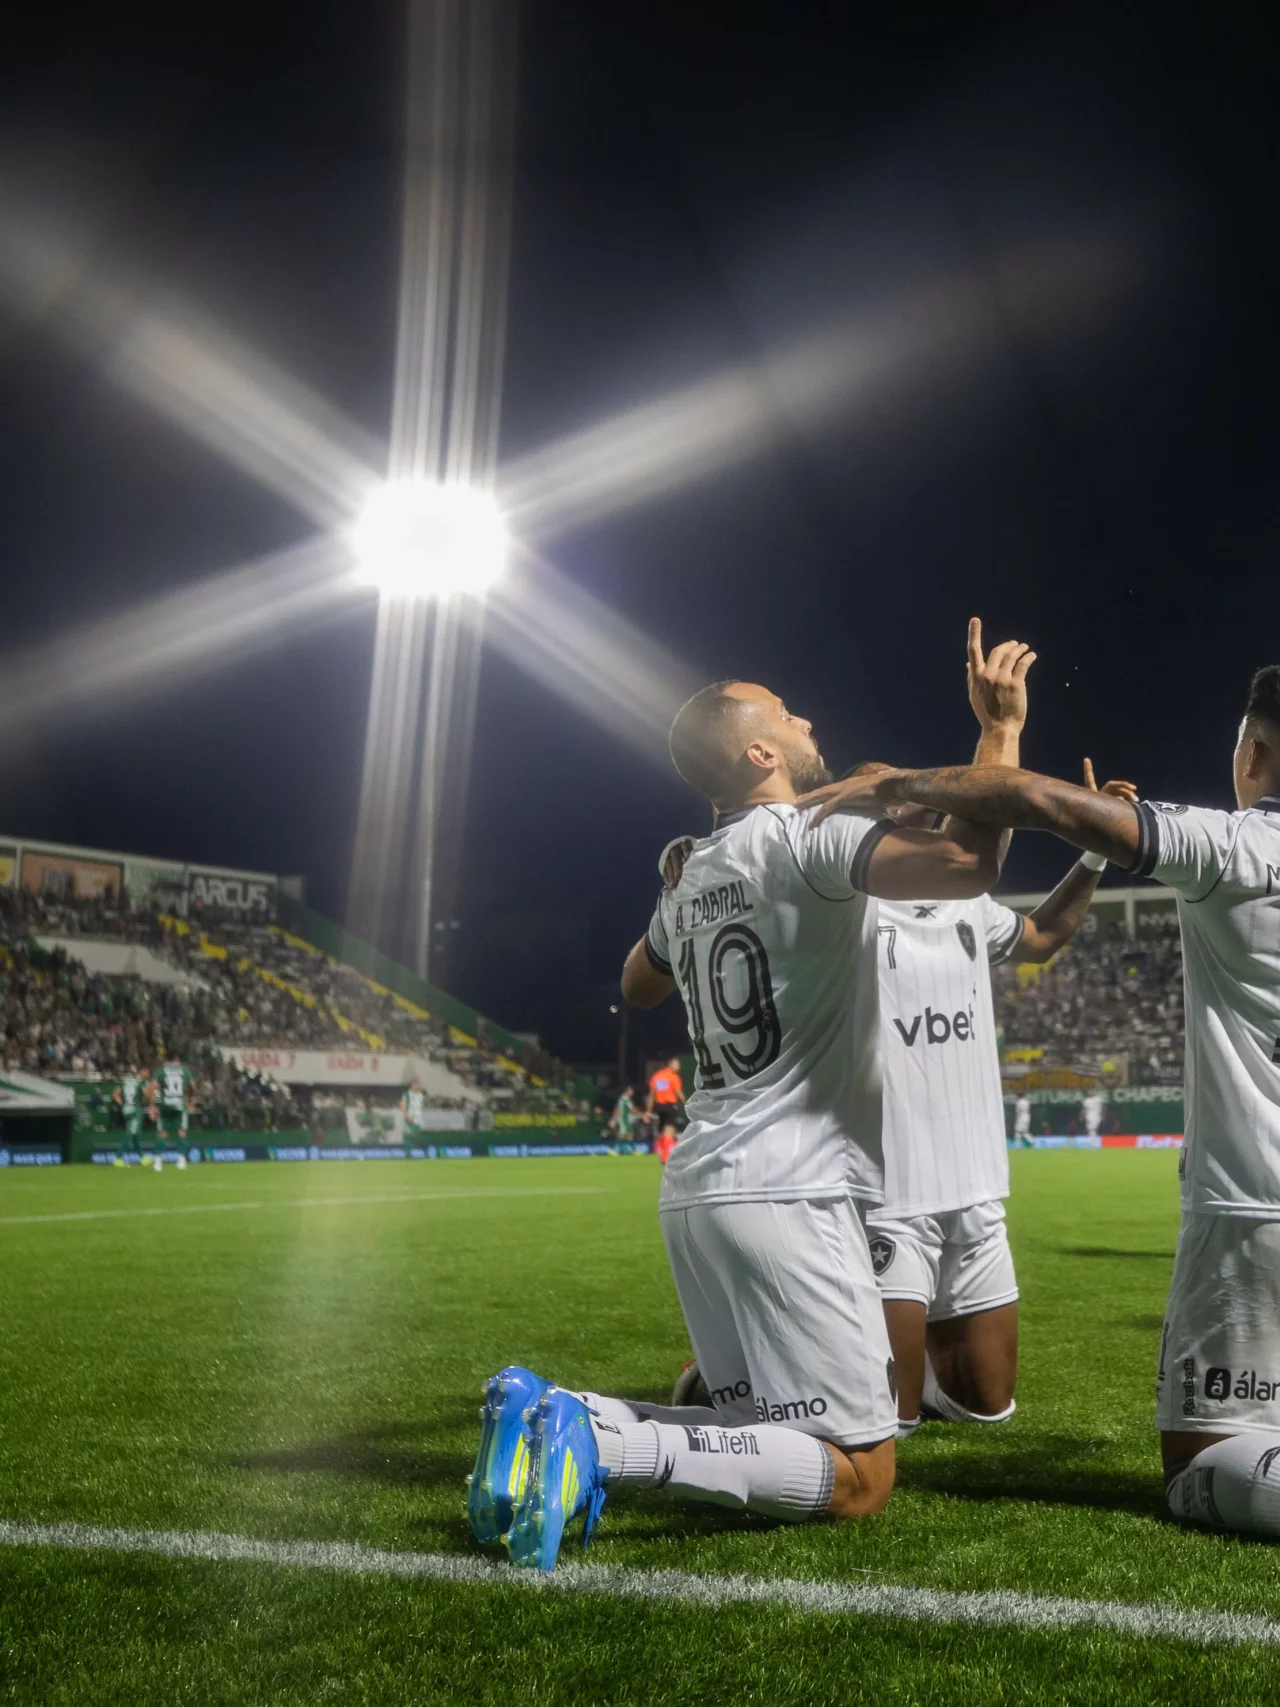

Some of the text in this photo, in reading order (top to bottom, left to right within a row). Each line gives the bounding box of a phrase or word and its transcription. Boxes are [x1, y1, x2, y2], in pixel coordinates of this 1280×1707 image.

[190, 875, 268, 910] ARCUS
[689, 879, 754, 929] CABRAL
[878, 925, 897, 970] 7
[677, 922, 783, 1089] 19
[756, 1396, 827, 1423] álamo
